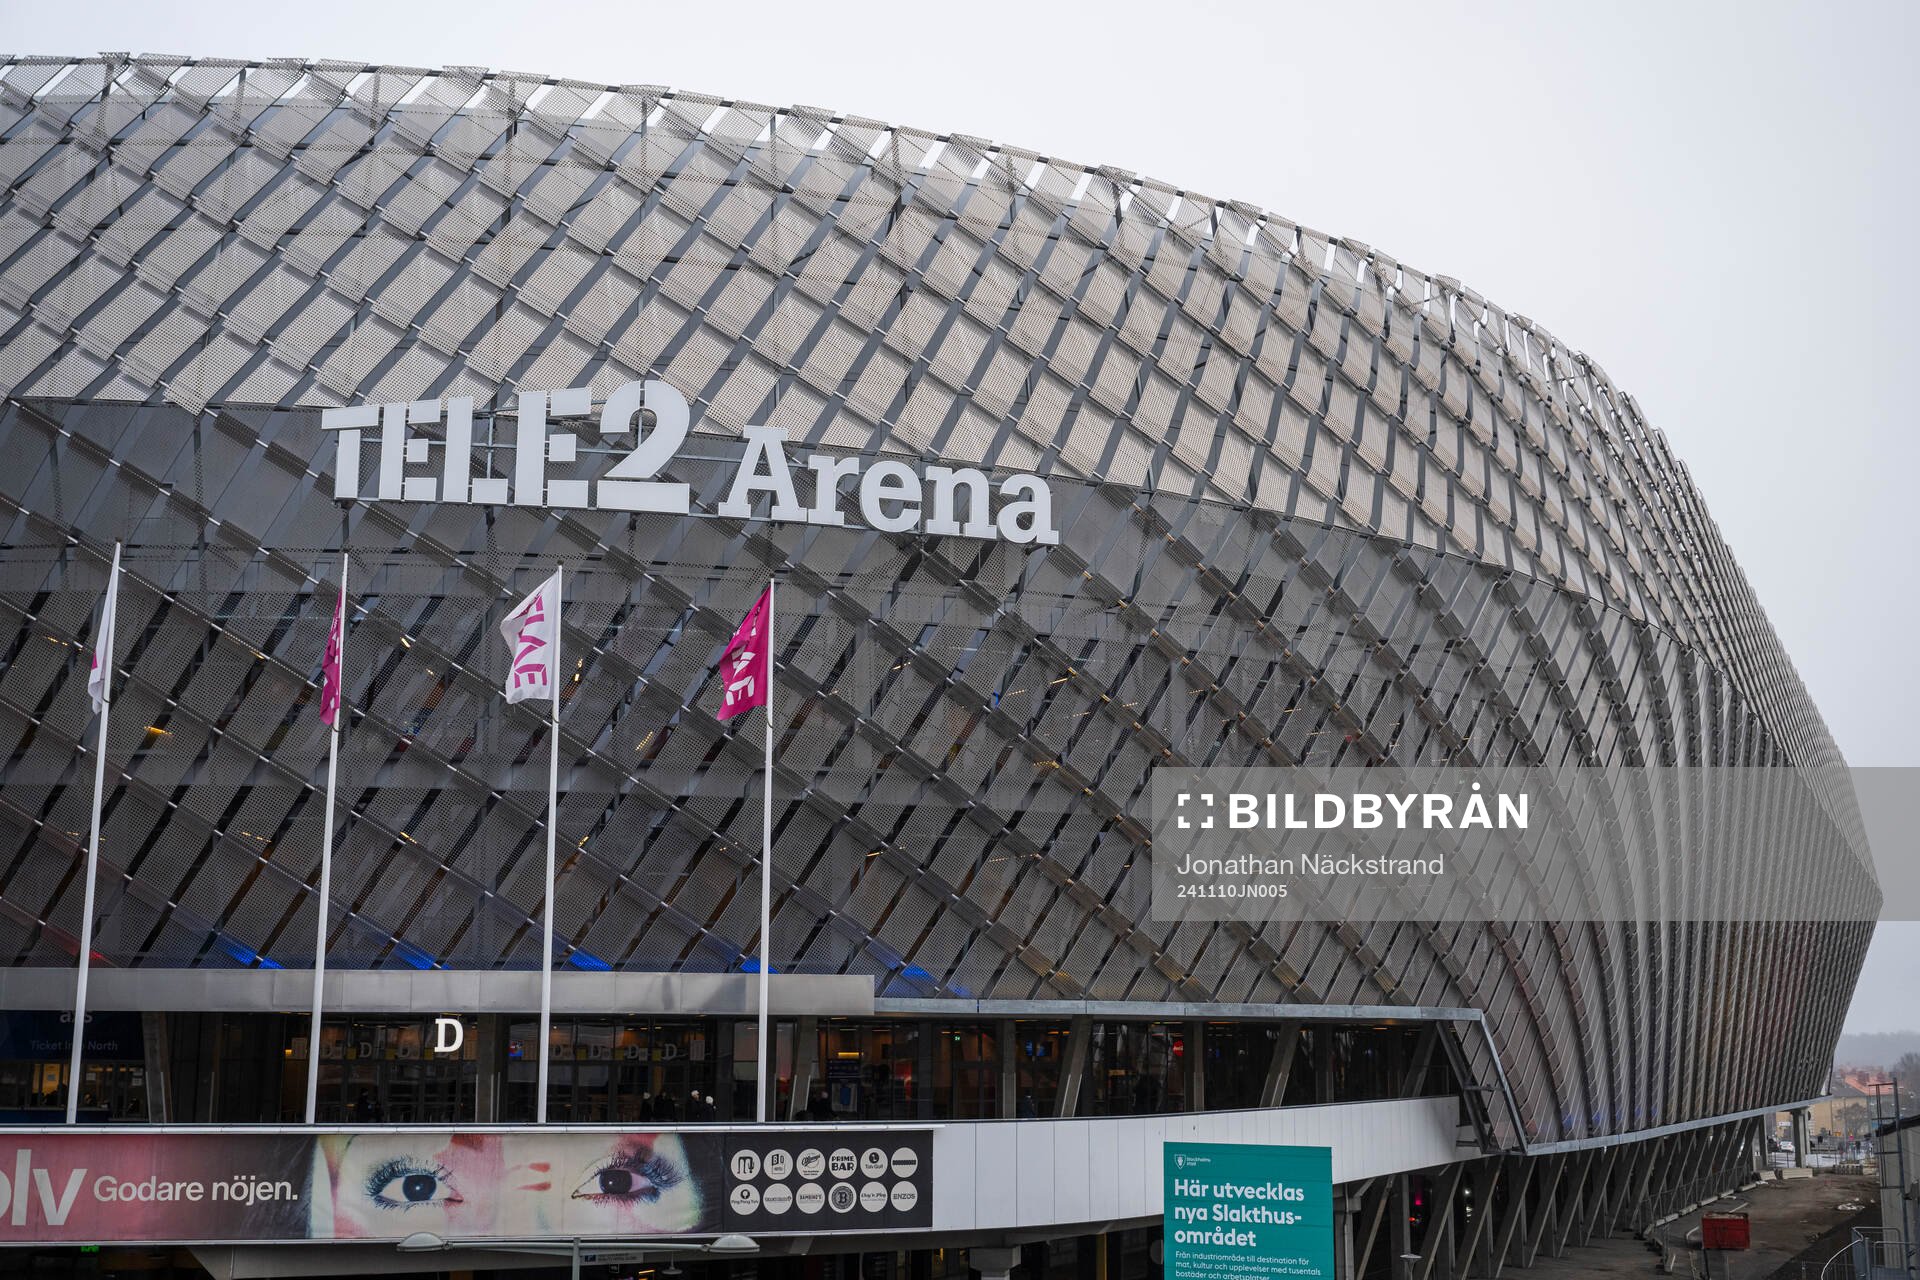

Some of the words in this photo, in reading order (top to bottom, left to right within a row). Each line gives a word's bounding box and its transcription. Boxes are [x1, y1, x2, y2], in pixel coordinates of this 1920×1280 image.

[321, 379, 690, 515] TELE2
[718, 425, 1059, 545] Arena
[87, 1040, 118, 1051] North
[434, 1018, 464, 1053] D
[831, 1162, 855, 1171] BAR
[0, 1149, 88, 1226] lv
[93, 1175, 203, 1201] Godare
[212, 1175, 298, 1206] nöjen.
[1174, 1178, 1209, 1197] Här
[1213, 1182, 1305, 1201] utvecklas
[1174, 1206, 1208, 1224] nya
[1212, 1203, 1302, 1225] Slakthus-
[1174, 1226, 1257, 1247] området
[1175, 1251, 1191, 1259] Från
[1192, 1252, 1246, 1262] industriområde
[1246, 1255, 1256, 1263] till
[1256, 1256, 1298, 1265] destination
[1298, 1257, 1309, 1266] för
[1193, 1261, 1213, 1270] kultur
[1229, 1263, 1270, 1273] upplevelser
[1271, 1266, 1288, 1274] med
[1288, 1267, 1321, 1276] tusentals
